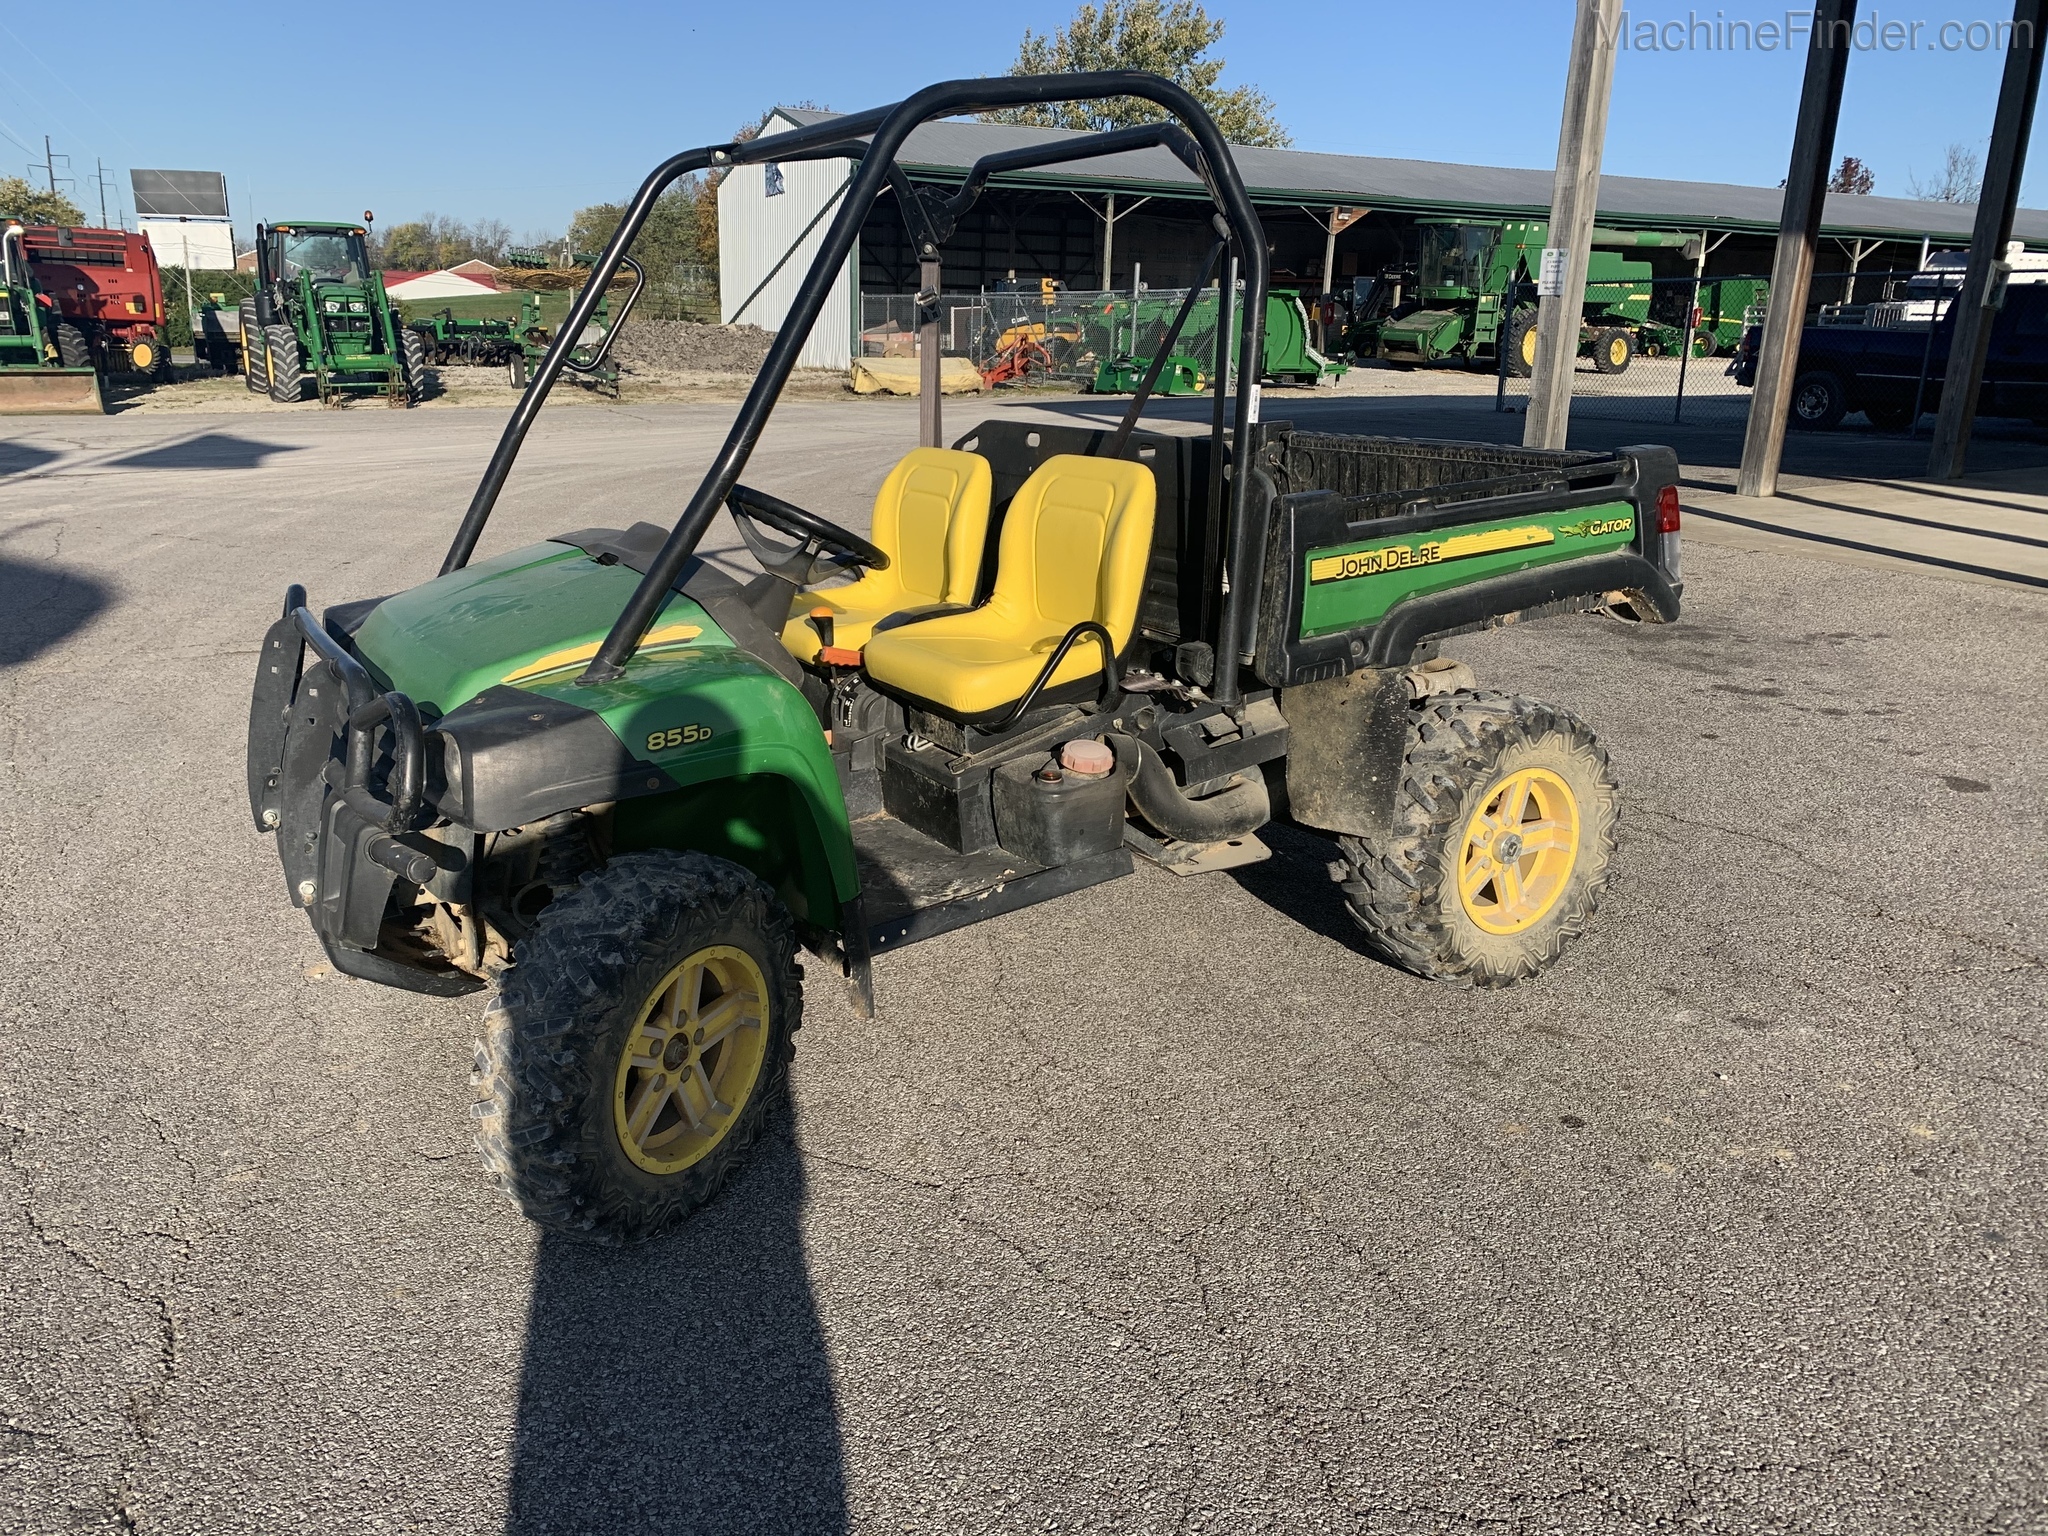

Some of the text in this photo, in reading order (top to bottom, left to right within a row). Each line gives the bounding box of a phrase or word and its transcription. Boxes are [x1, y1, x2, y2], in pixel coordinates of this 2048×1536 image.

[1590, 518, 1632, 536] GATOR
[1336, 546, 1440, 577] JOHN DEERE
[647, 724, 712, 751] 855D
